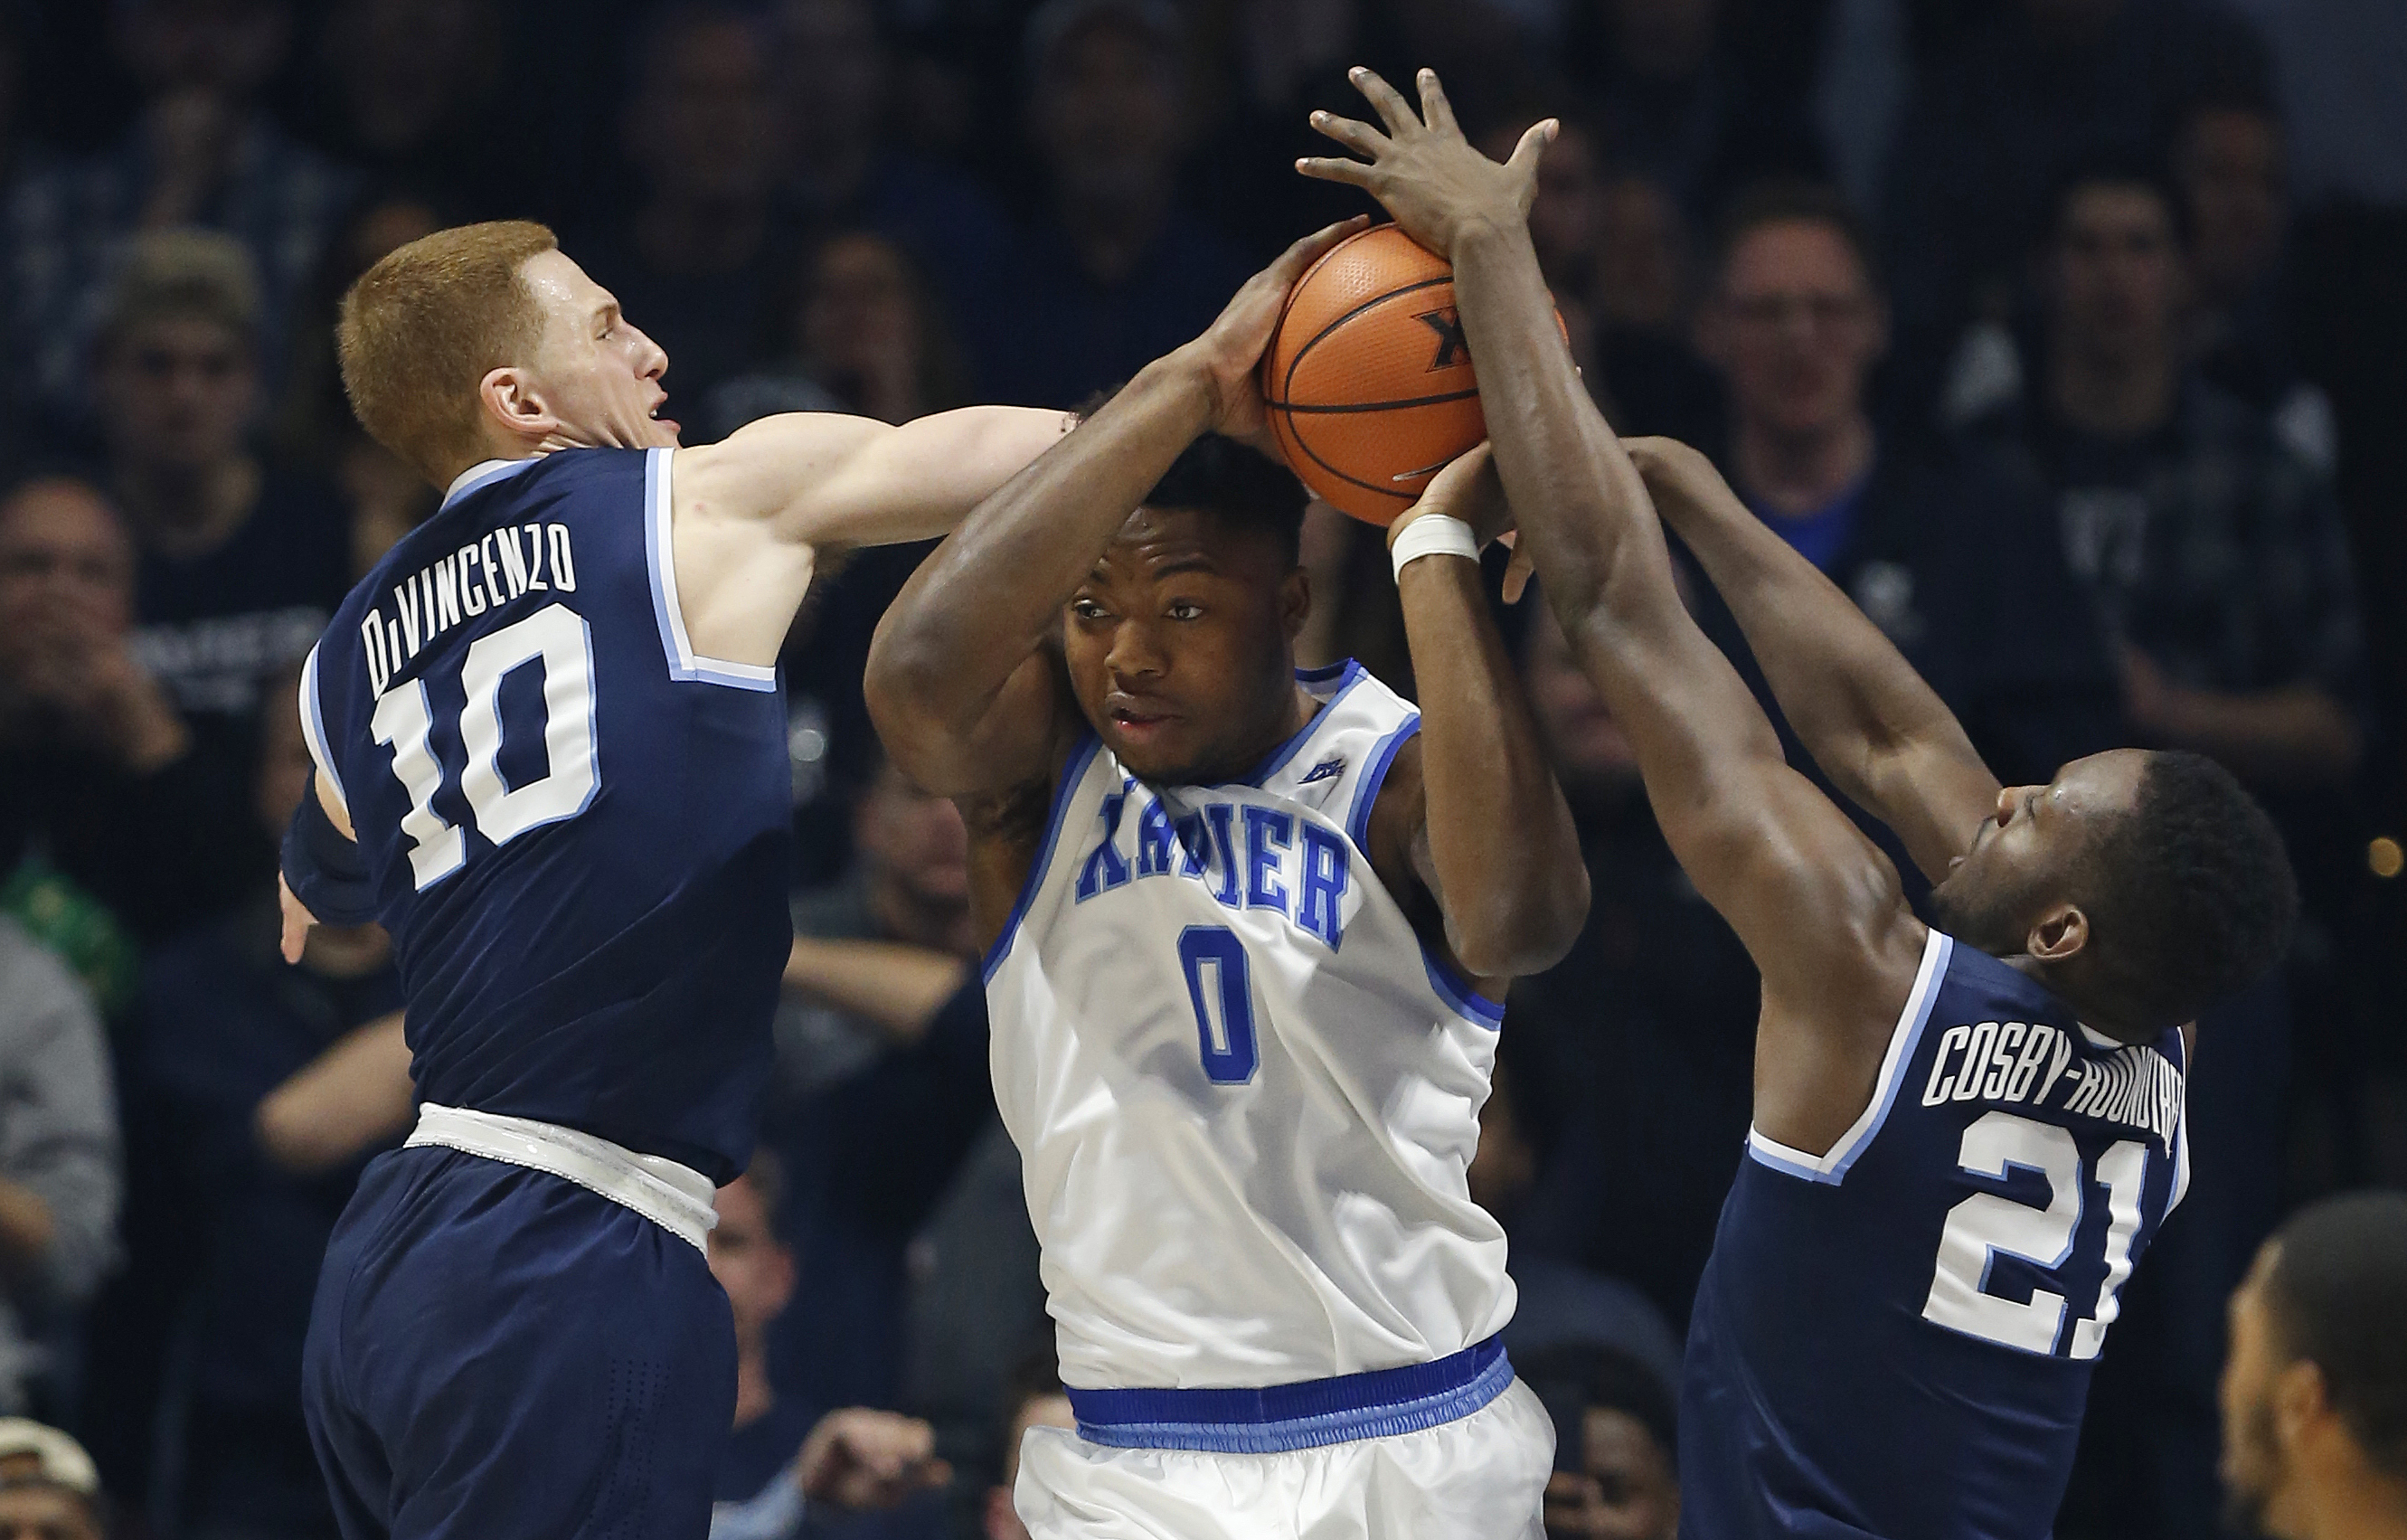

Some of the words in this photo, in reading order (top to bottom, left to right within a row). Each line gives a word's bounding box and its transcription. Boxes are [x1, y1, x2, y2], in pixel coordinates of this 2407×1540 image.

[370, 601, 602, 894] 10
[1176, 924, 1260, 1086] 0
[1921, 1110, 2150, 1361] 21
